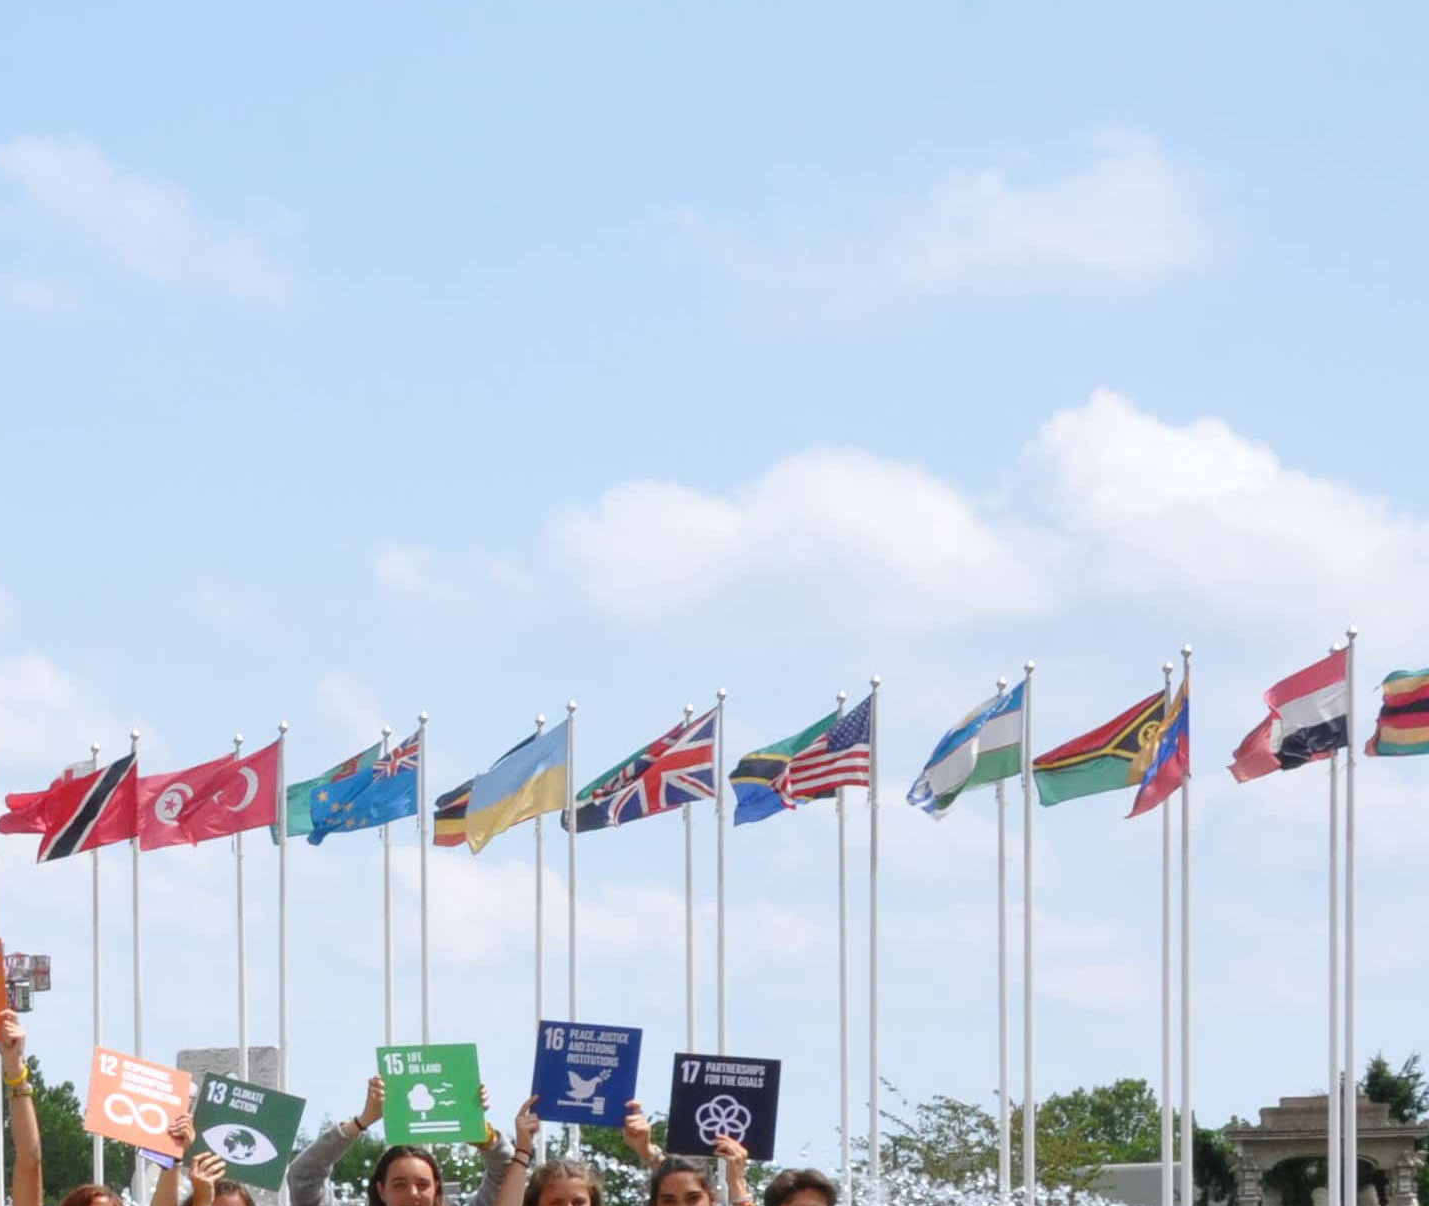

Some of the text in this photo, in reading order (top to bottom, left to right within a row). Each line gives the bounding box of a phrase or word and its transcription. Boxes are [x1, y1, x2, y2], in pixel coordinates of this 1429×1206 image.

[545, 1028, 565, 1051] 16
[568, 1042, 586, 1052] AND
[99, 1054, 118, 1077] 12
[384, 1053, 404, 1075] 15
[407, 1052, 422, 1063] LIFE
[421, 1063, 442, 1074] LAND
[681, 1061, 701, 1084] 17
[704, 1074, 764, 1088] FOR THE GOALS
[207, 1080, 228, 1104] 13
[232, 1086, 265, 1105] CLIMATE
[229, 1098, 259, 1114] ACTION
